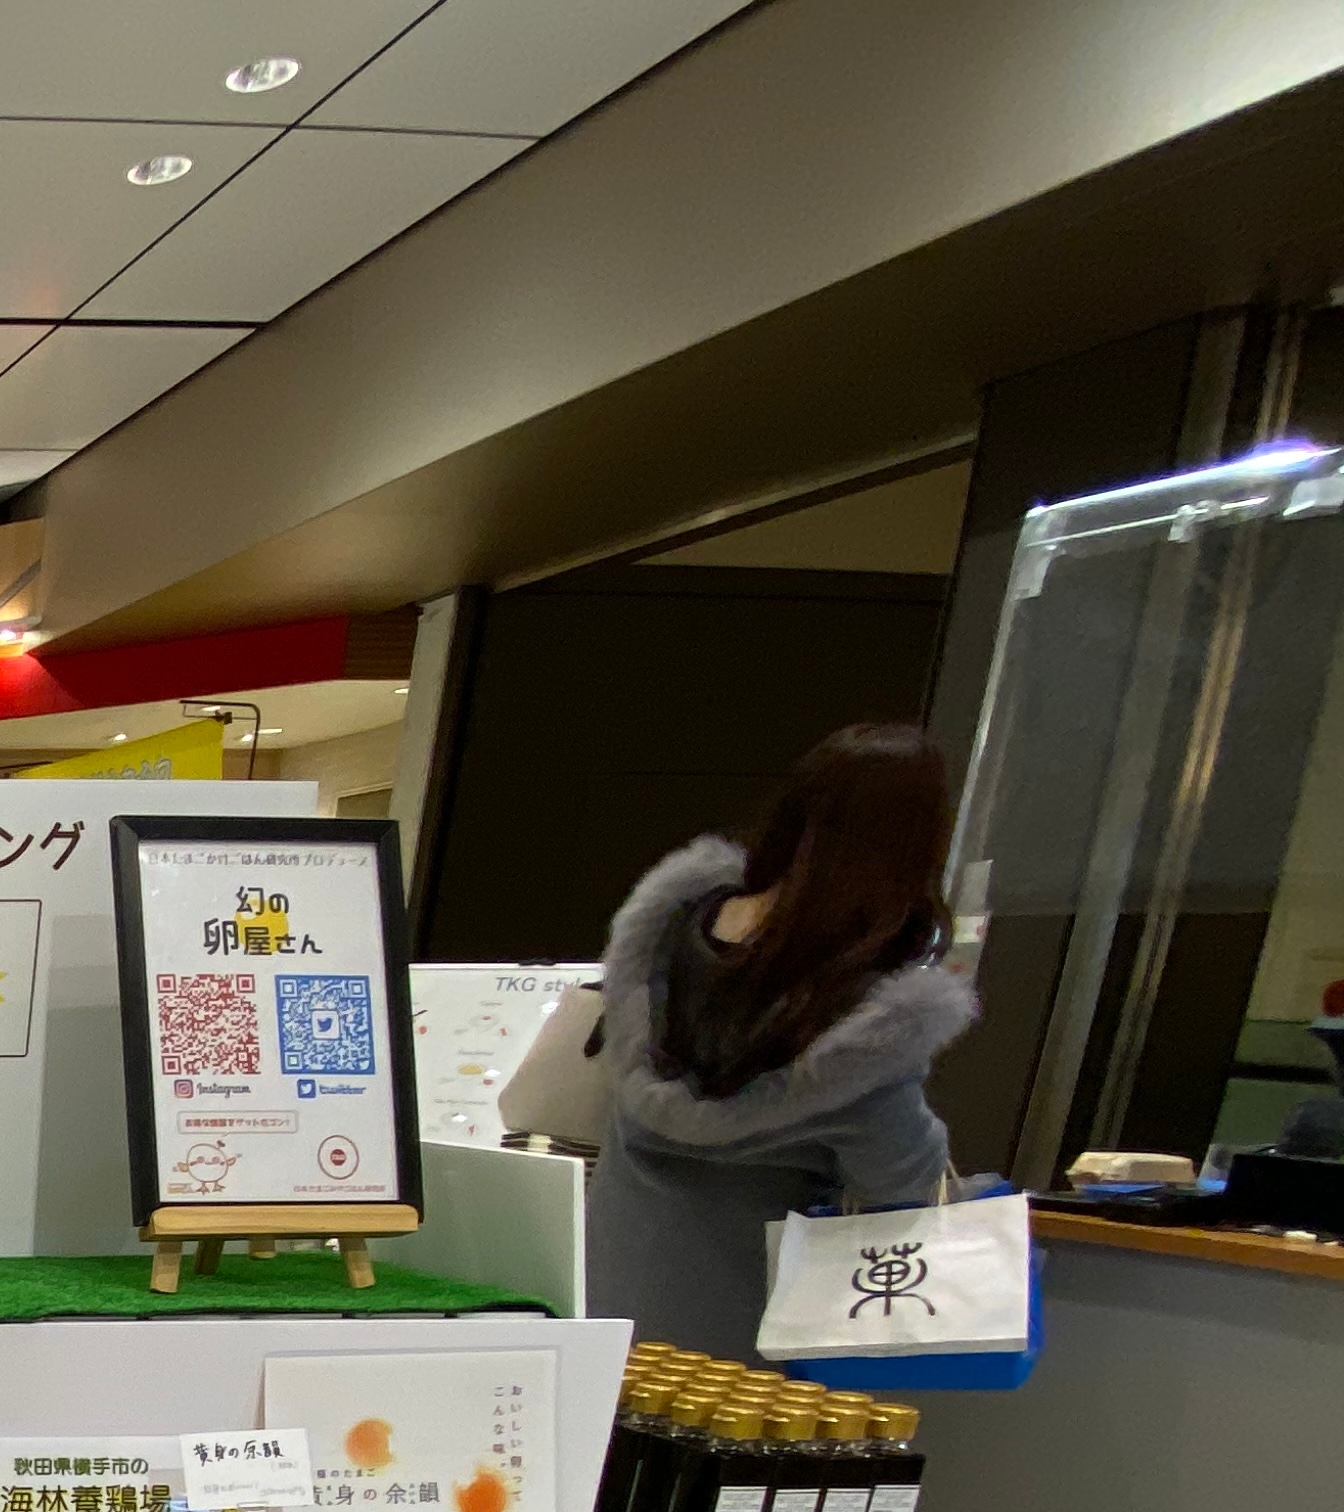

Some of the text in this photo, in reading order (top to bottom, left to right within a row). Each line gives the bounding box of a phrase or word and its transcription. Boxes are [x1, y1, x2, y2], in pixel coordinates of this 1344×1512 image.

[236, 885, 290, 915] 幻の
[203, 917, 323, 956] 卵屋さん
[495, 976, 537, 992] TKG
[13, 1456, 150, 1476] 秋田県横手市の
